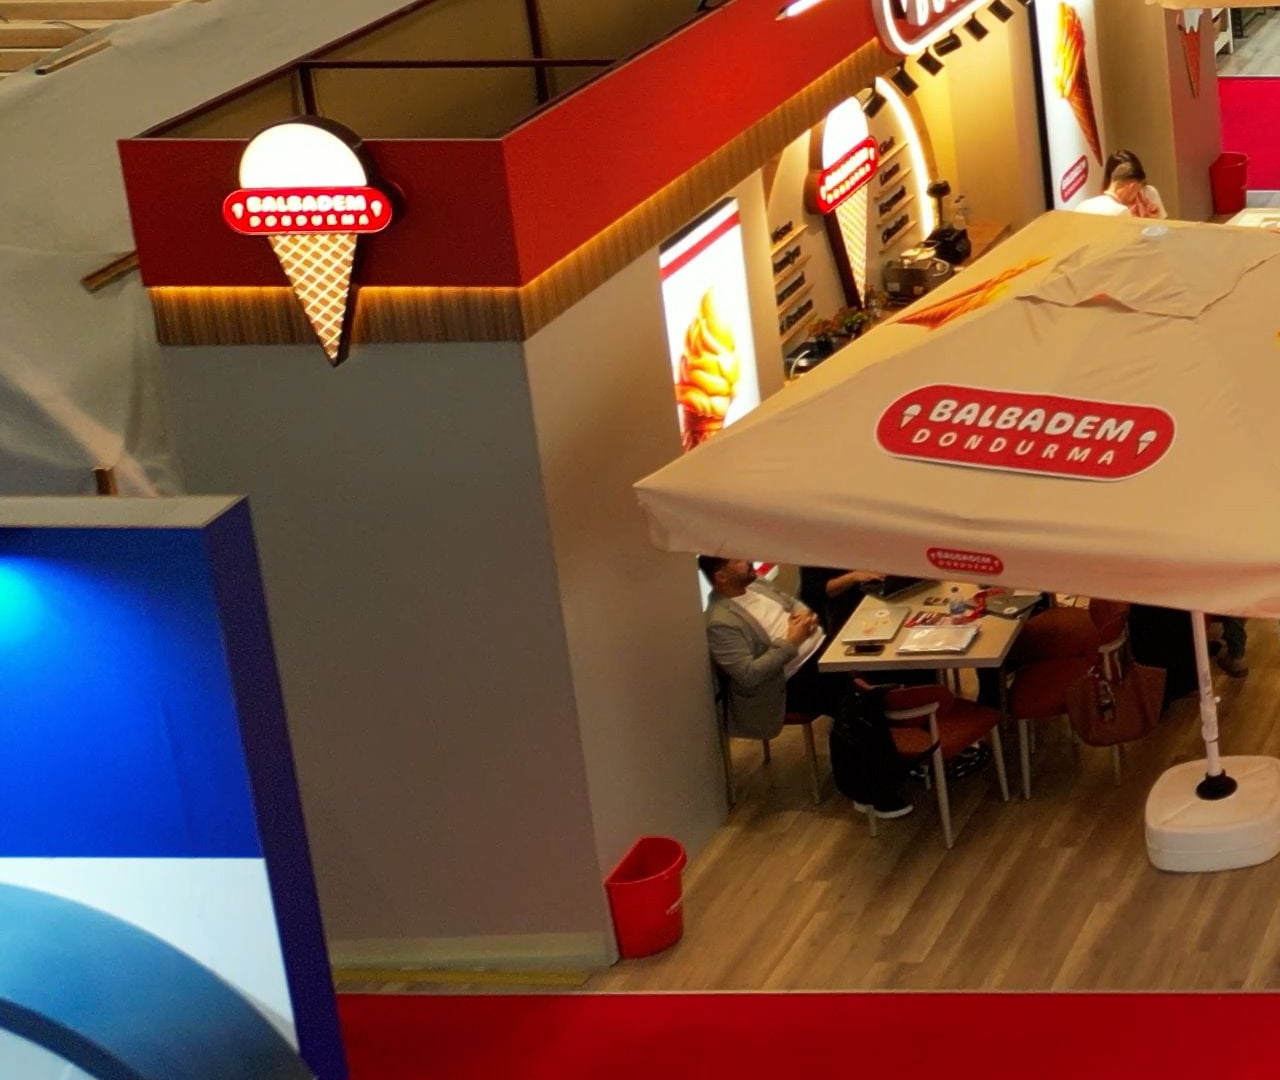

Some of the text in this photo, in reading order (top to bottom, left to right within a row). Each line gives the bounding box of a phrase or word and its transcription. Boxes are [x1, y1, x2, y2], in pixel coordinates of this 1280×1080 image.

[246, 195, 366, 213] BALBADEM
[929, 399, 1135, 443] BALBADEM
[912, 428, 1116, 465] DONDURMA
